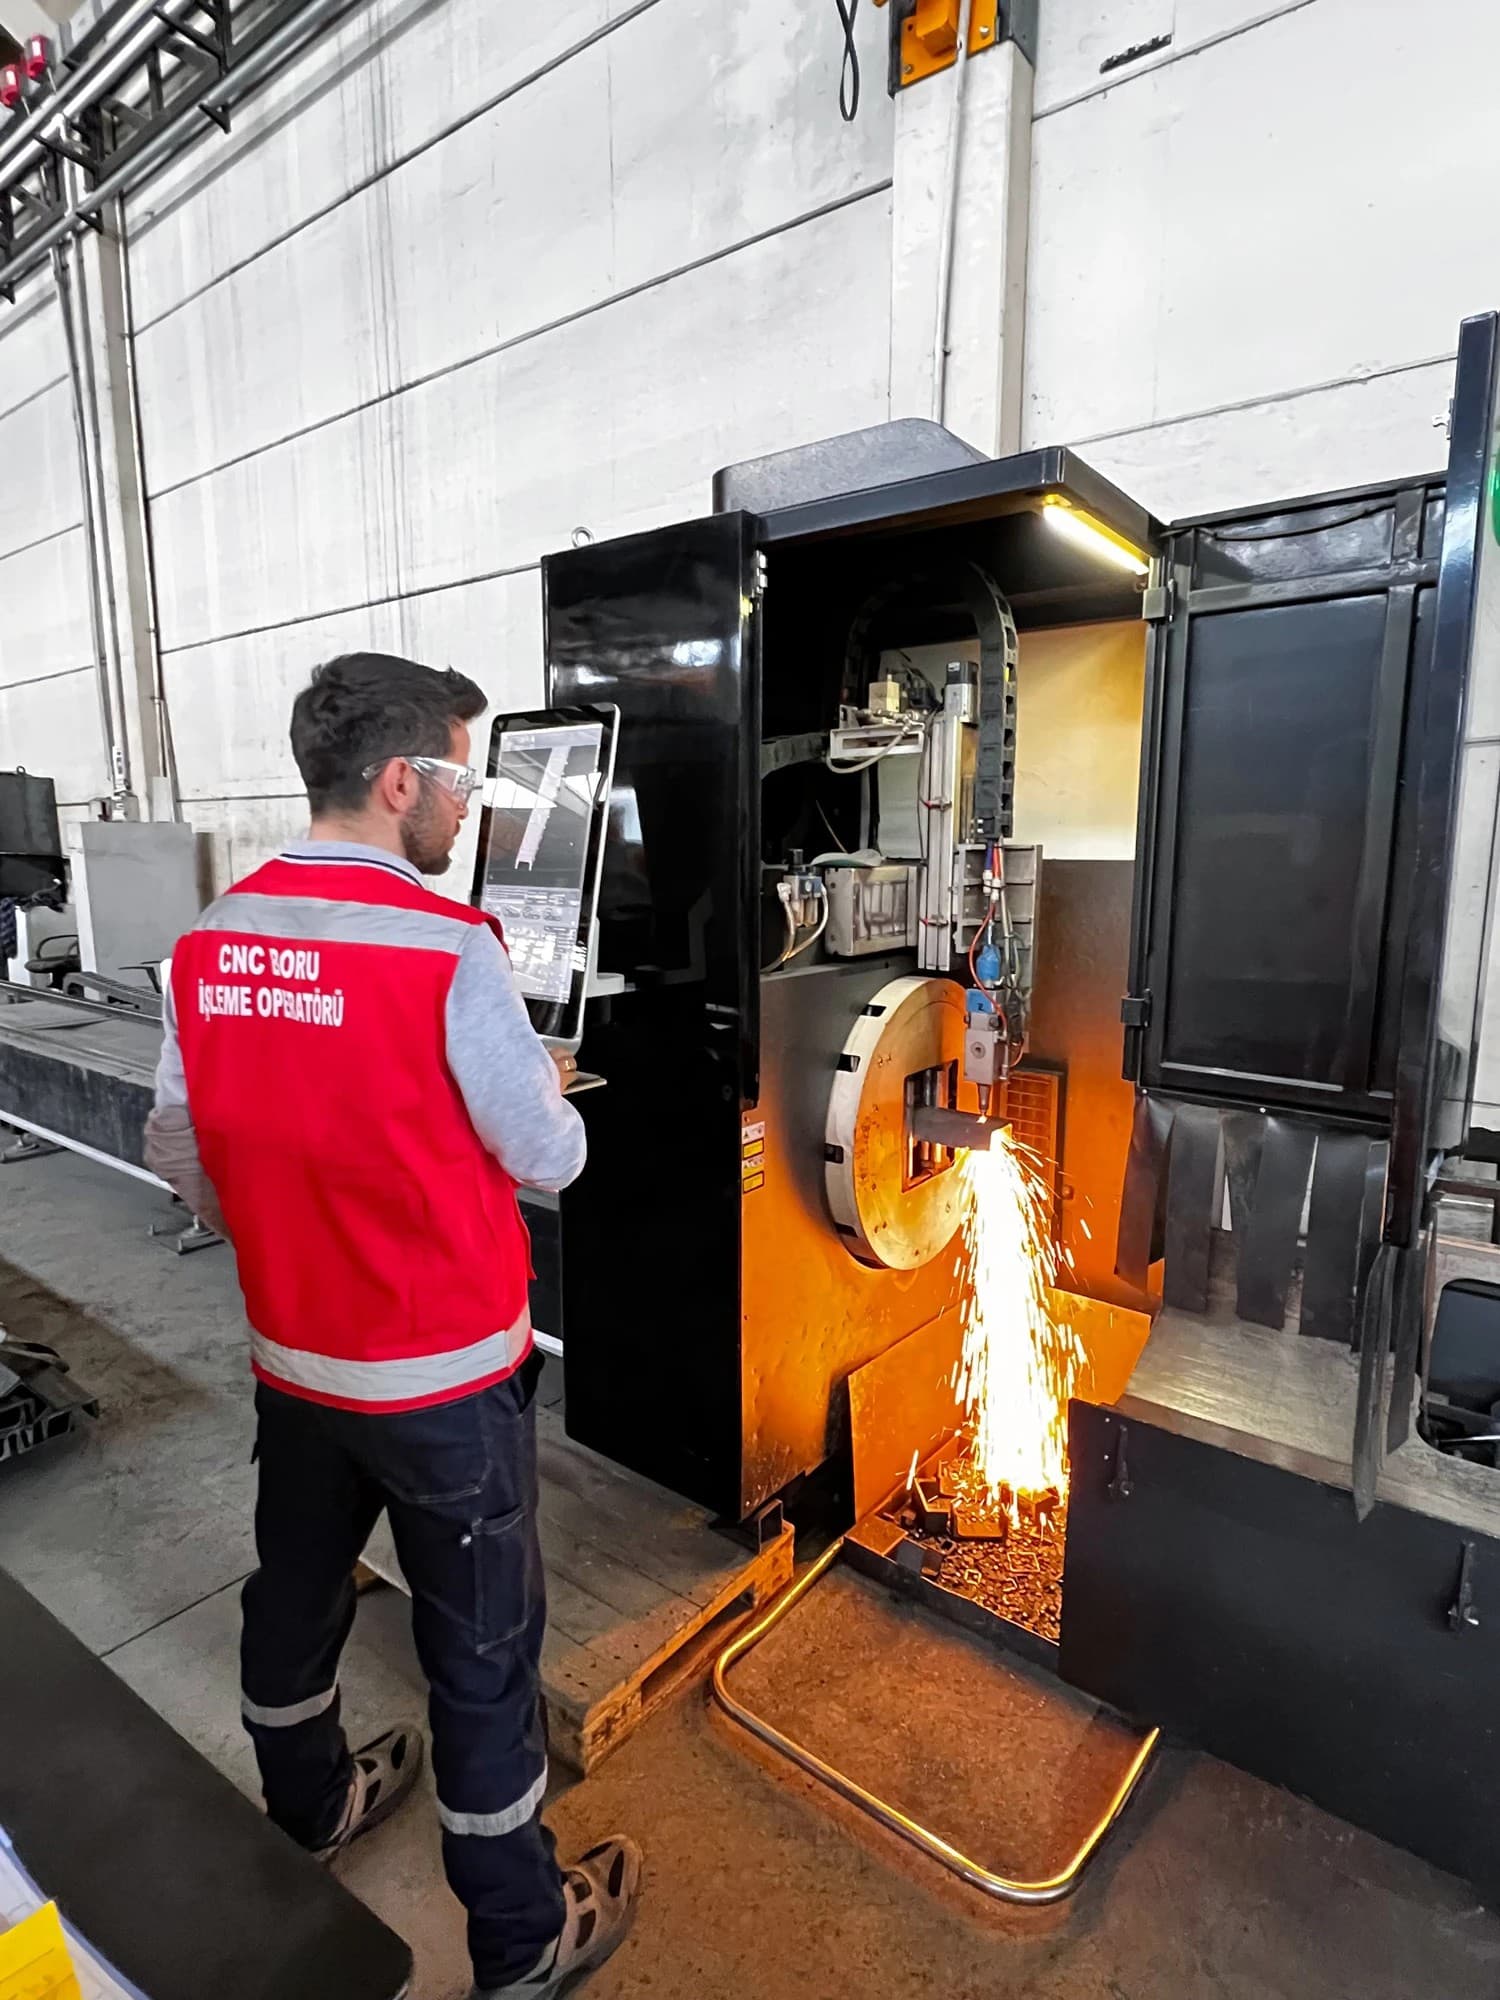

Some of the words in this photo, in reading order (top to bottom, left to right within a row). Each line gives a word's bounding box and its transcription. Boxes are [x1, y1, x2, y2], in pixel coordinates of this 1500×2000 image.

[219, 944, 265, 975] CNC
[269, 948, 320, 981] BORU
[198, 978, 253, 1022] İŞLEME
